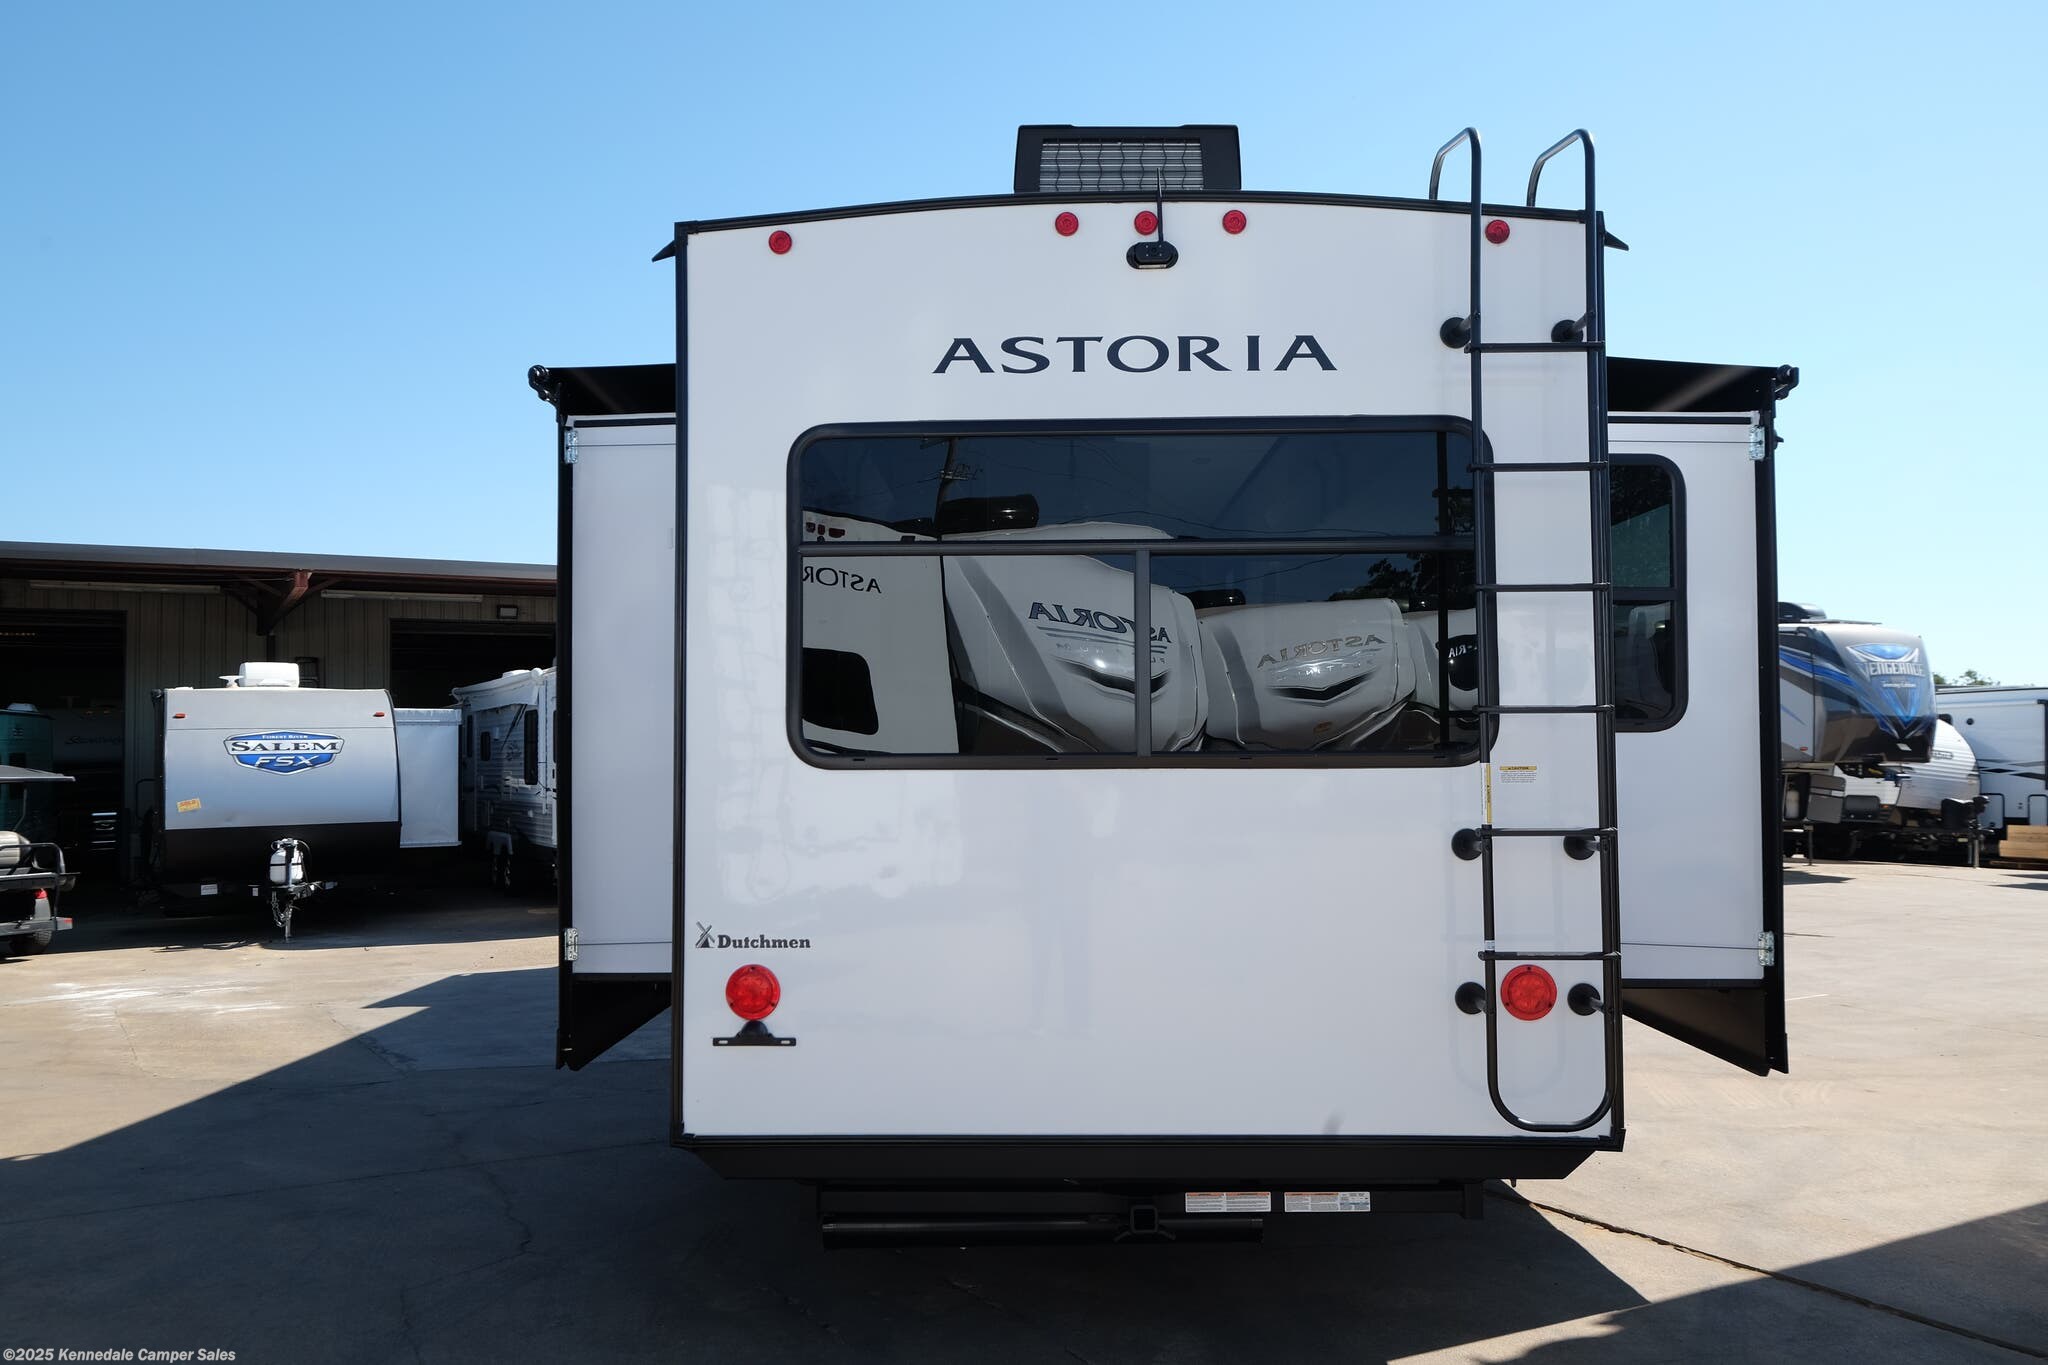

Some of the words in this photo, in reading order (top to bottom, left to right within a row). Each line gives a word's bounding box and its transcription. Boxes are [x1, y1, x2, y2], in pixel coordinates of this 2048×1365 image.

[932, 335, 1338, 374] ASTORIA
[1855, 661, 1926, 682] VENGEANCE
[231, 741, 340, 752] SALEM
[255, 755, 320, 767] FSX
[717, 934, 811, 949] Dutchmen
